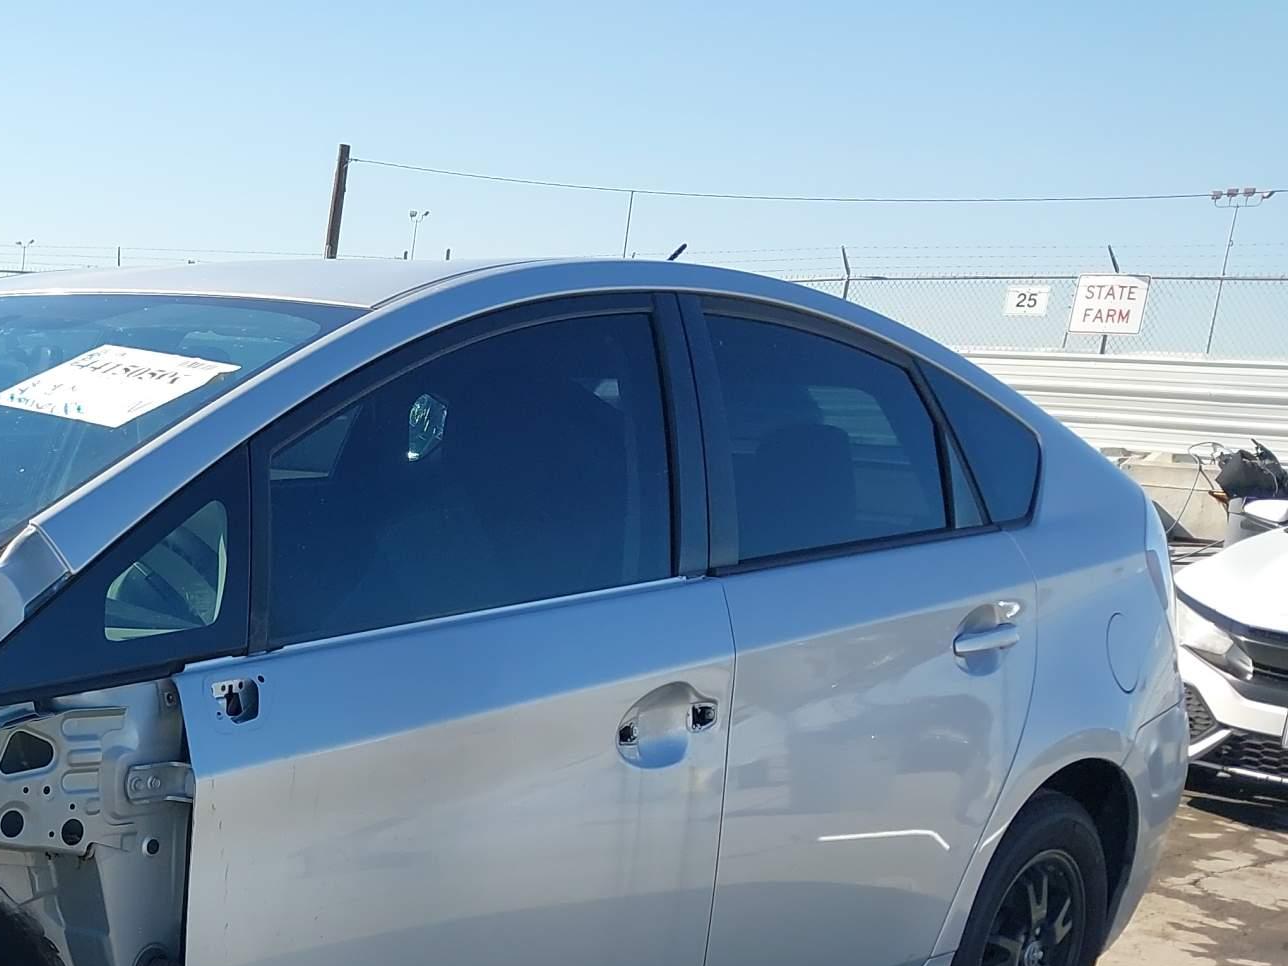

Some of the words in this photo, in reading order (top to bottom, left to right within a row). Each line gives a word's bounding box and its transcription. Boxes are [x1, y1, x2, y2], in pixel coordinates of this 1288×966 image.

[1016, 293, 1037, 308] 25
[1085, 285, 1137, 301] STATE
[1082, 308, 1131, 324] FARM
